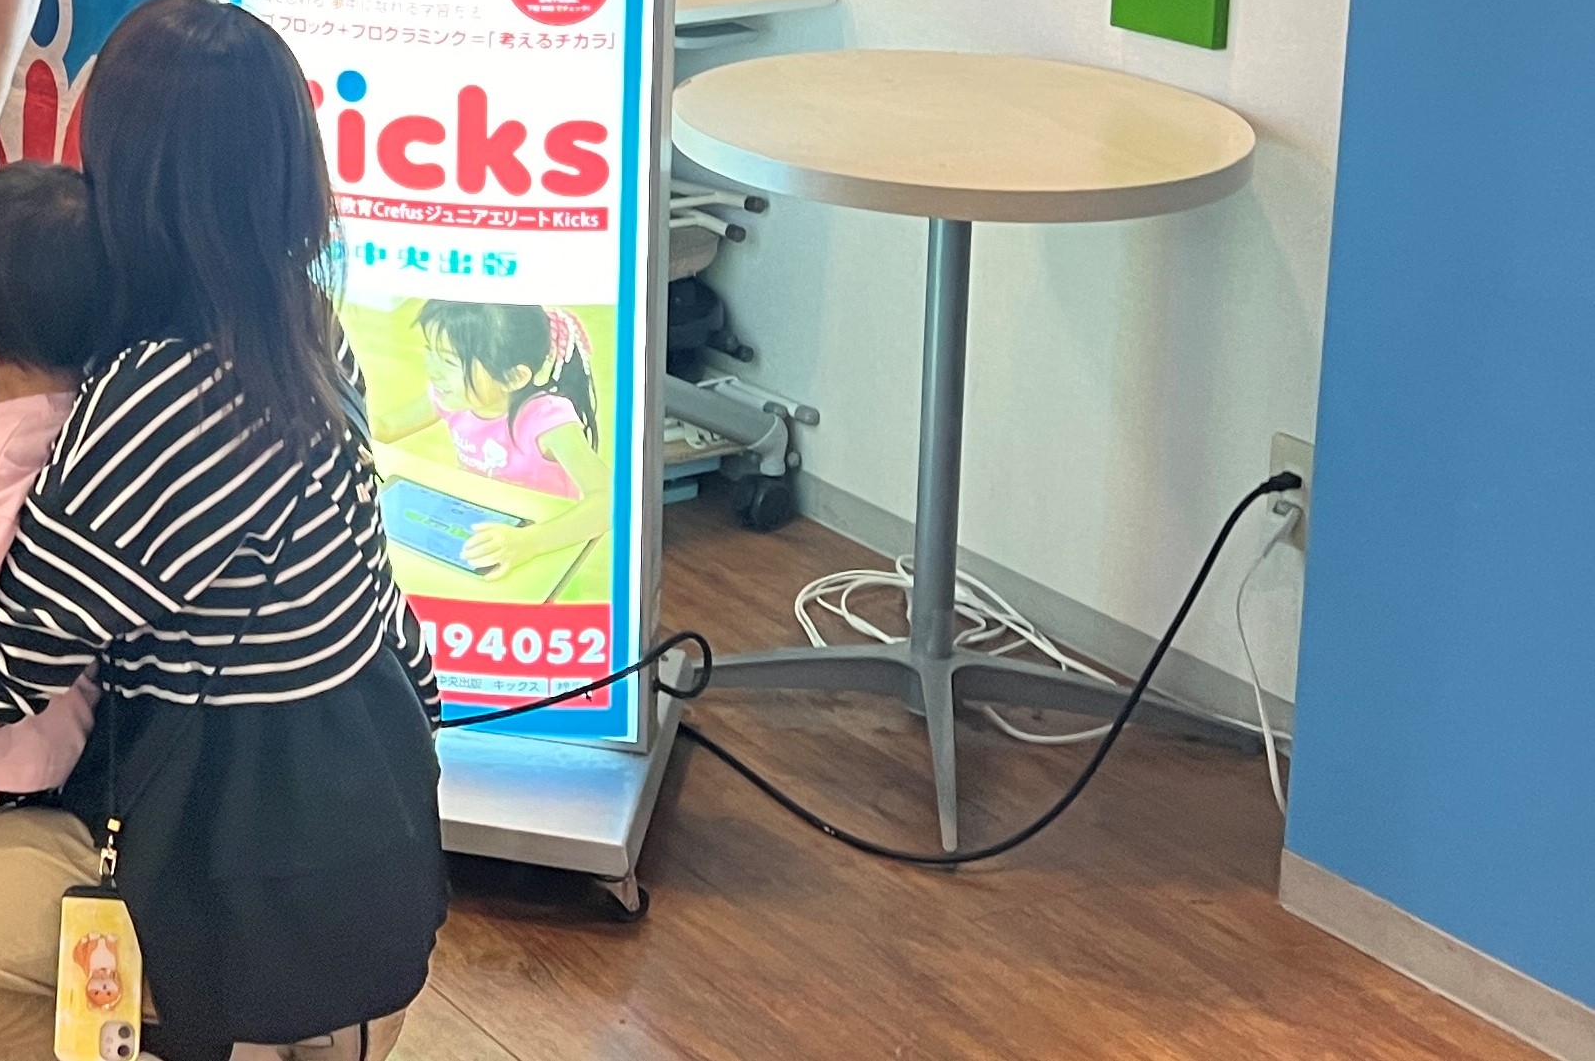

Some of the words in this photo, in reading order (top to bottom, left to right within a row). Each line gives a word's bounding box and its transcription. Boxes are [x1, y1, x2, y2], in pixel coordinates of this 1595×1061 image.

[307, 70, 610, 197] icks
[355, 242, 517, 277] 中央出版
[420, 621, 605, 664] 194052
[493, 680, 540, 692] キックス
